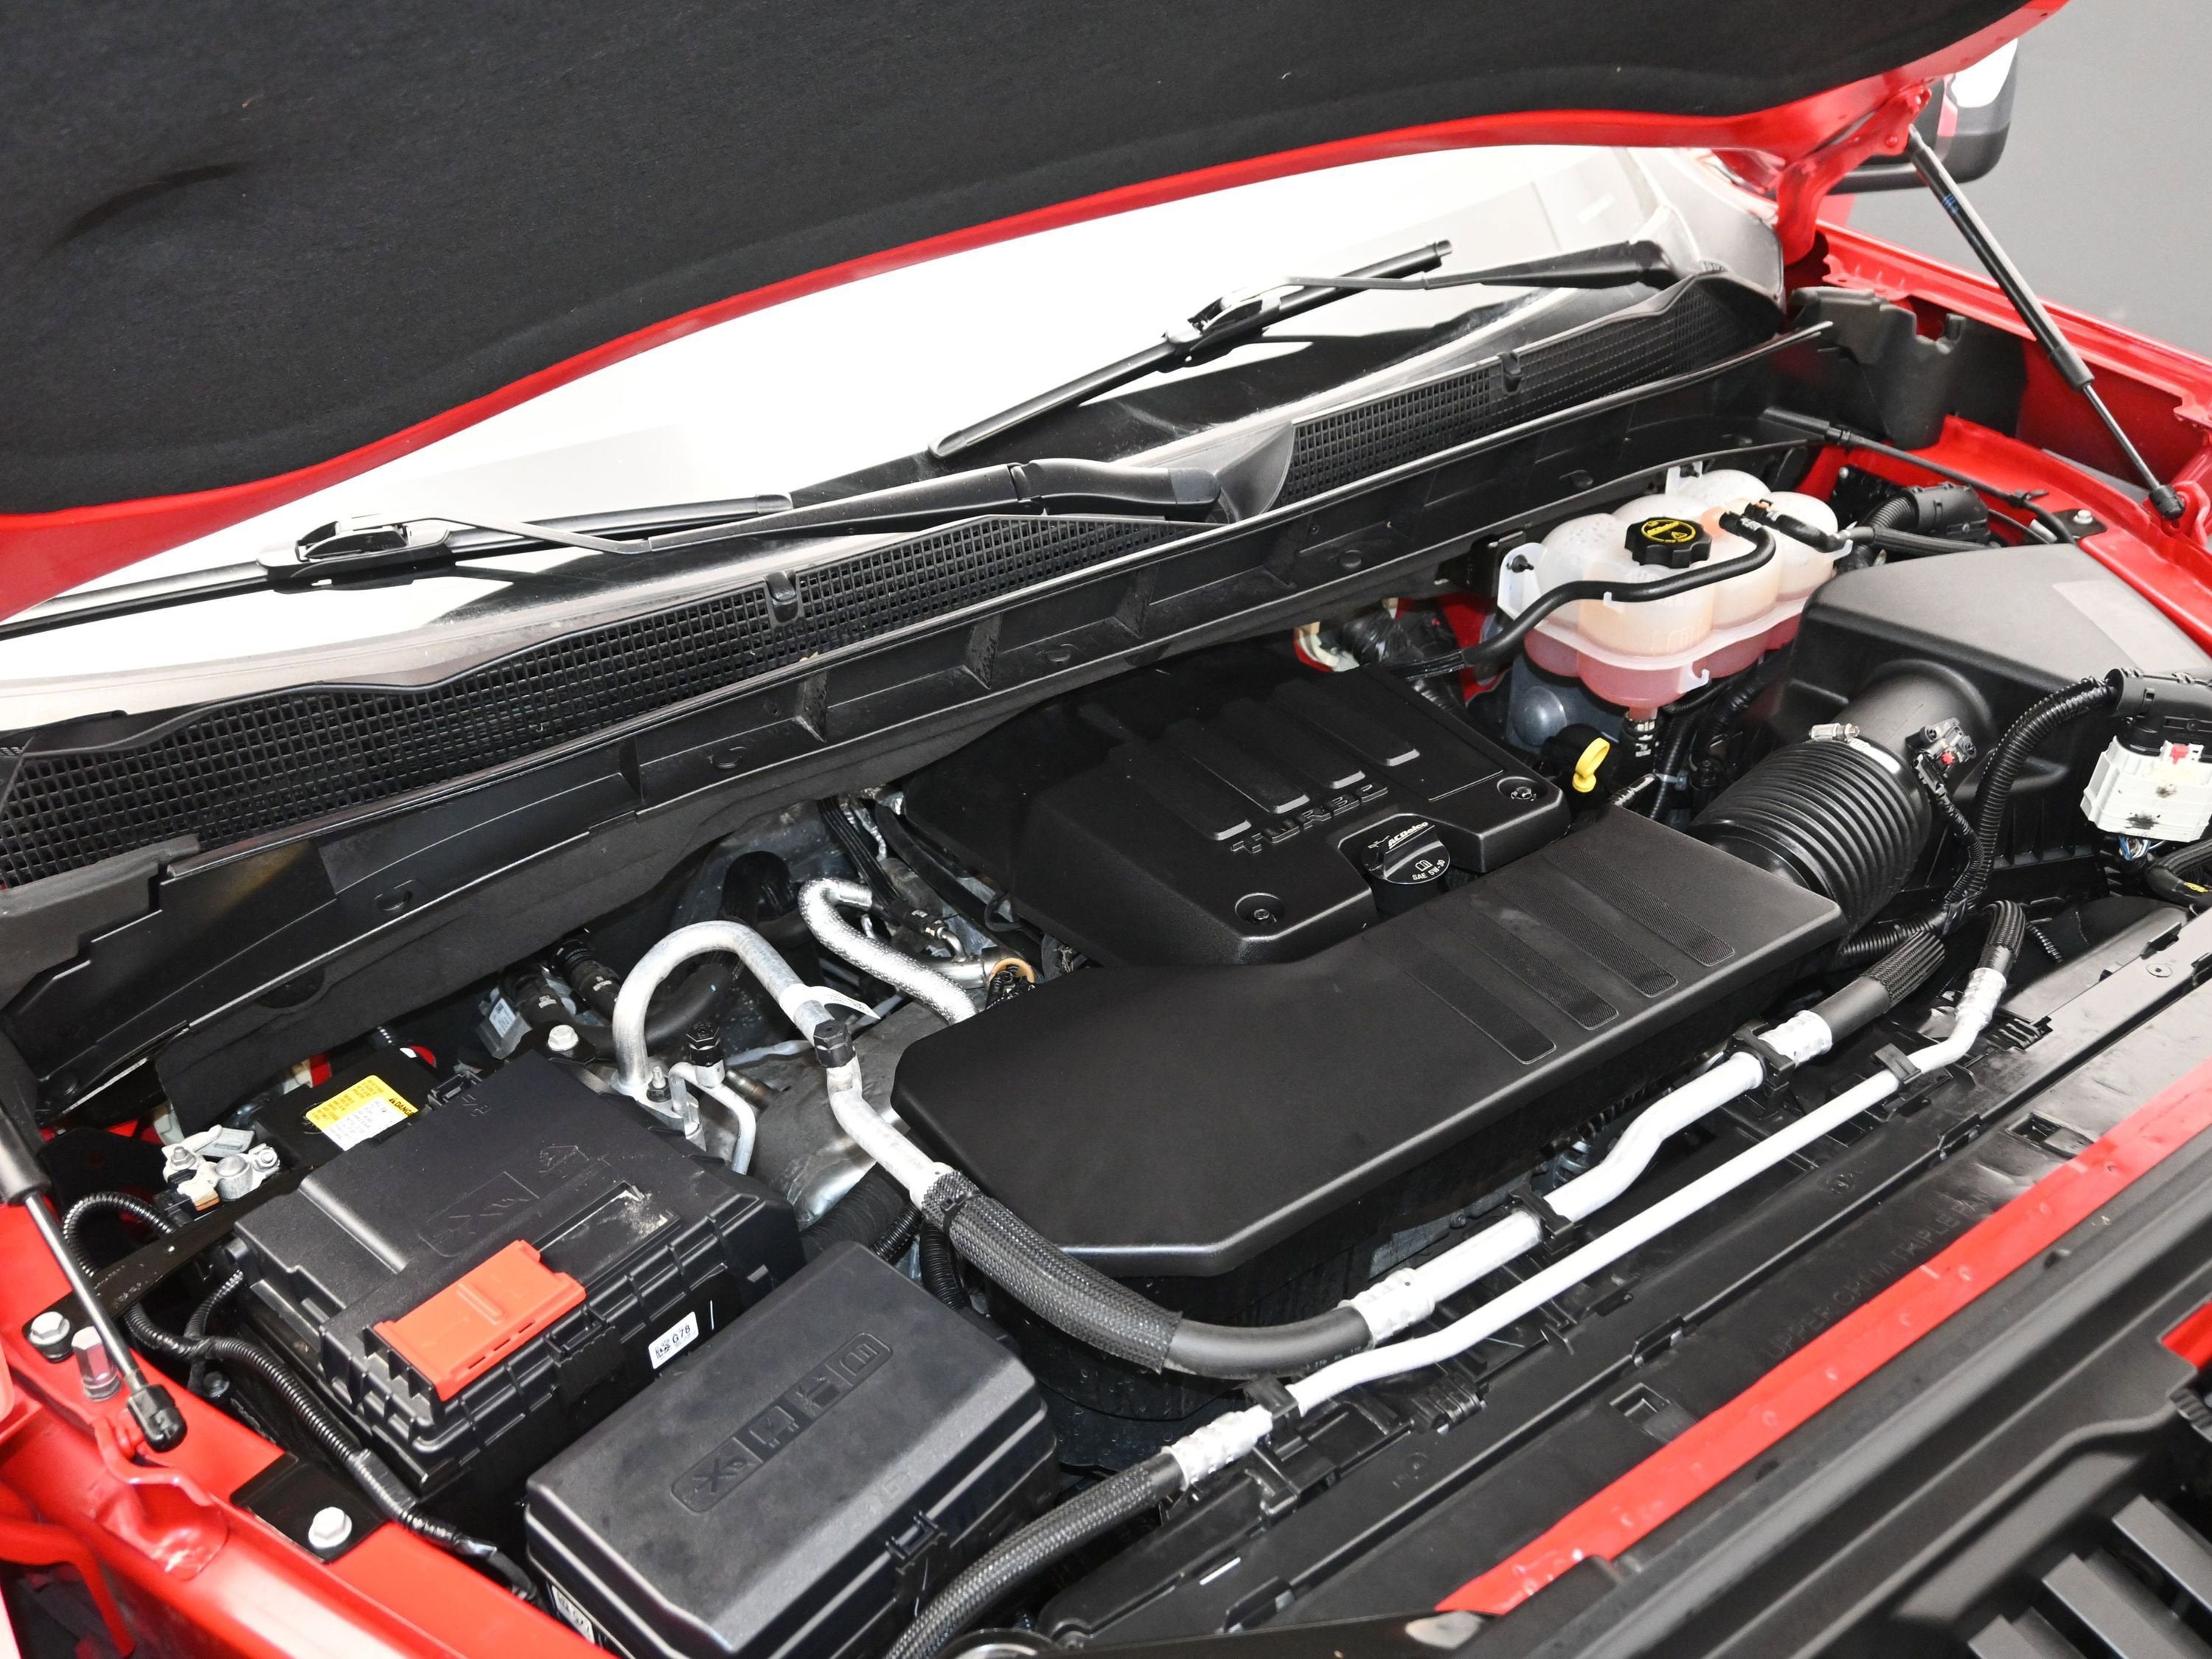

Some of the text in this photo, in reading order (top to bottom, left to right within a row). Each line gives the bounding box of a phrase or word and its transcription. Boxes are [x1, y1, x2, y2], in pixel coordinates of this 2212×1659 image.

[1230, 783, 1389, 854] TURBO
[1388, 821, 1429, 849] ACDelco
[1412, 859, 1446, 880] SAE 5W-30
[672, 1324, 691, 1343] G78
